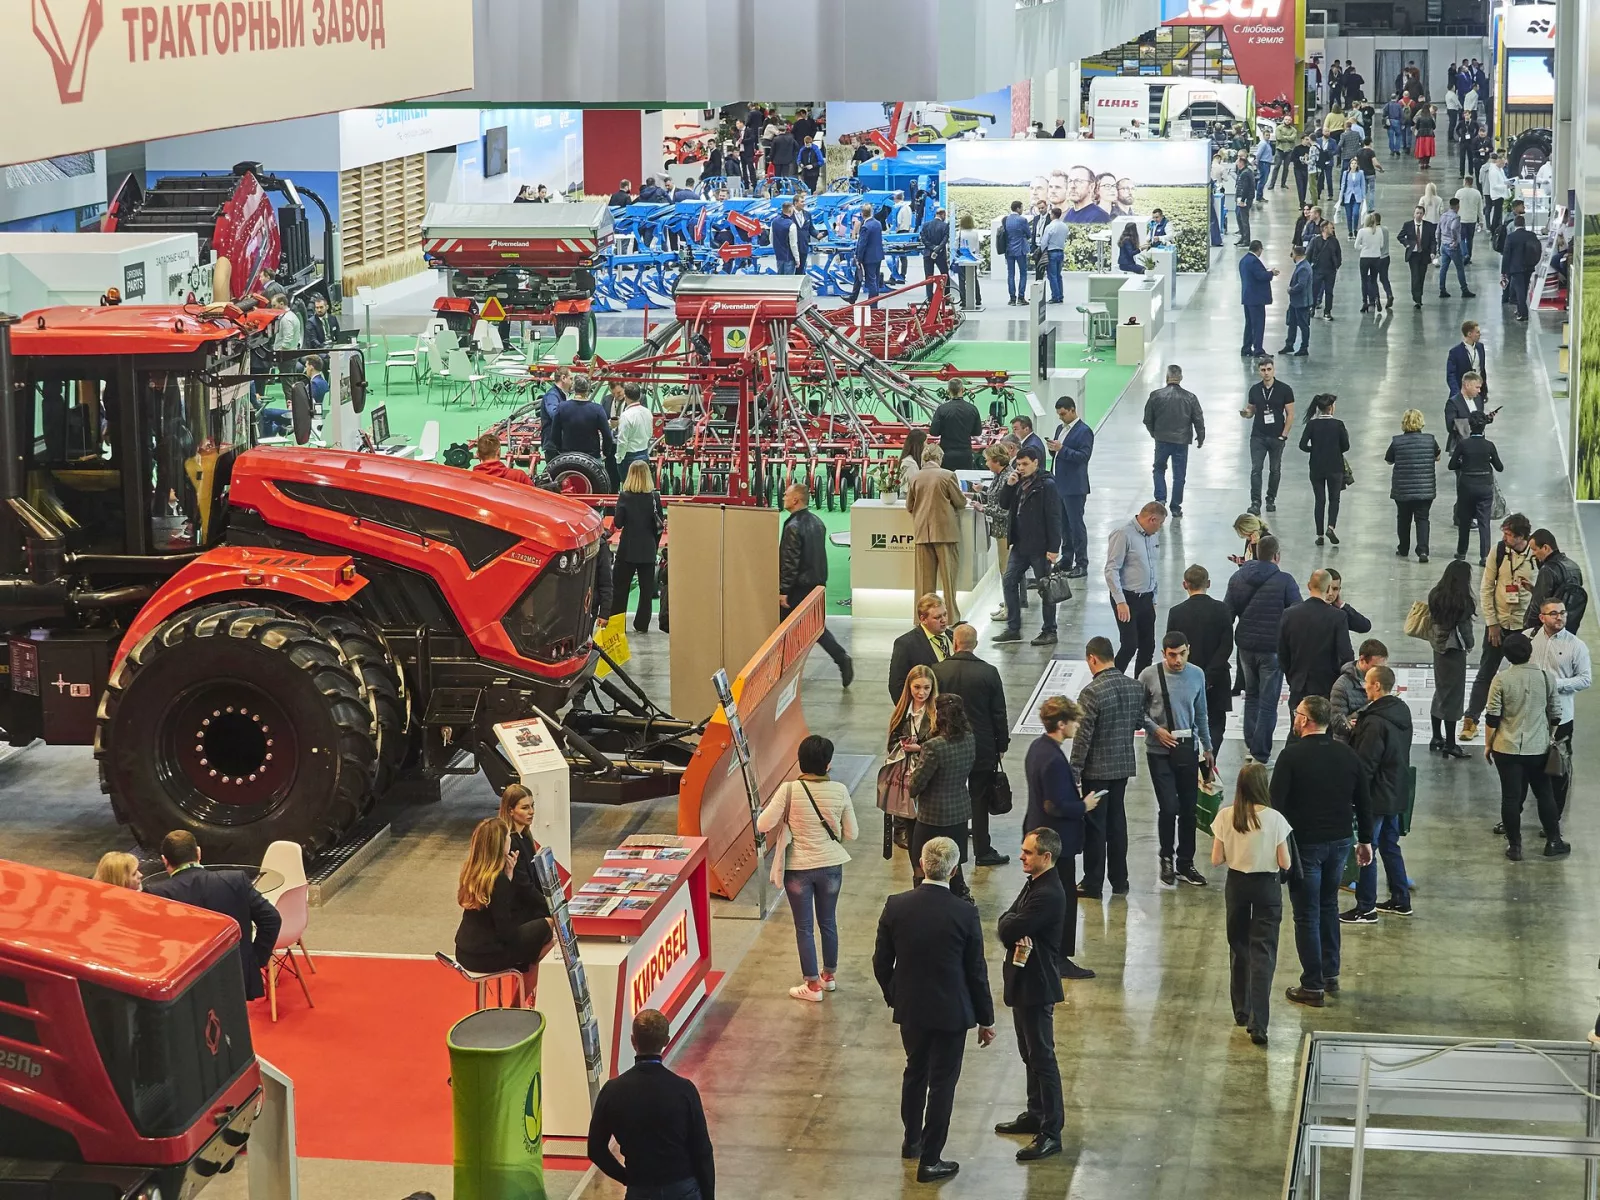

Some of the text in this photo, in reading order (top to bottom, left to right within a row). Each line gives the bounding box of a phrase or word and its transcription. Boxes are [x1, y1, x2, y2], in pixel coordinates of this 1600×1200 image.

[312, 0, 386, 50] ЗАВОД
[1233, 24, 1285, 34] С любовью
[1248, 36, 1285, 44] к земле
[1097, 99, 1139, 108] CLAAS
[126, 278, 144, 293] PARTS
[890, 534, 914, 544] АГР
[633, 909, 688, 1016] КИРОВЕЦ
